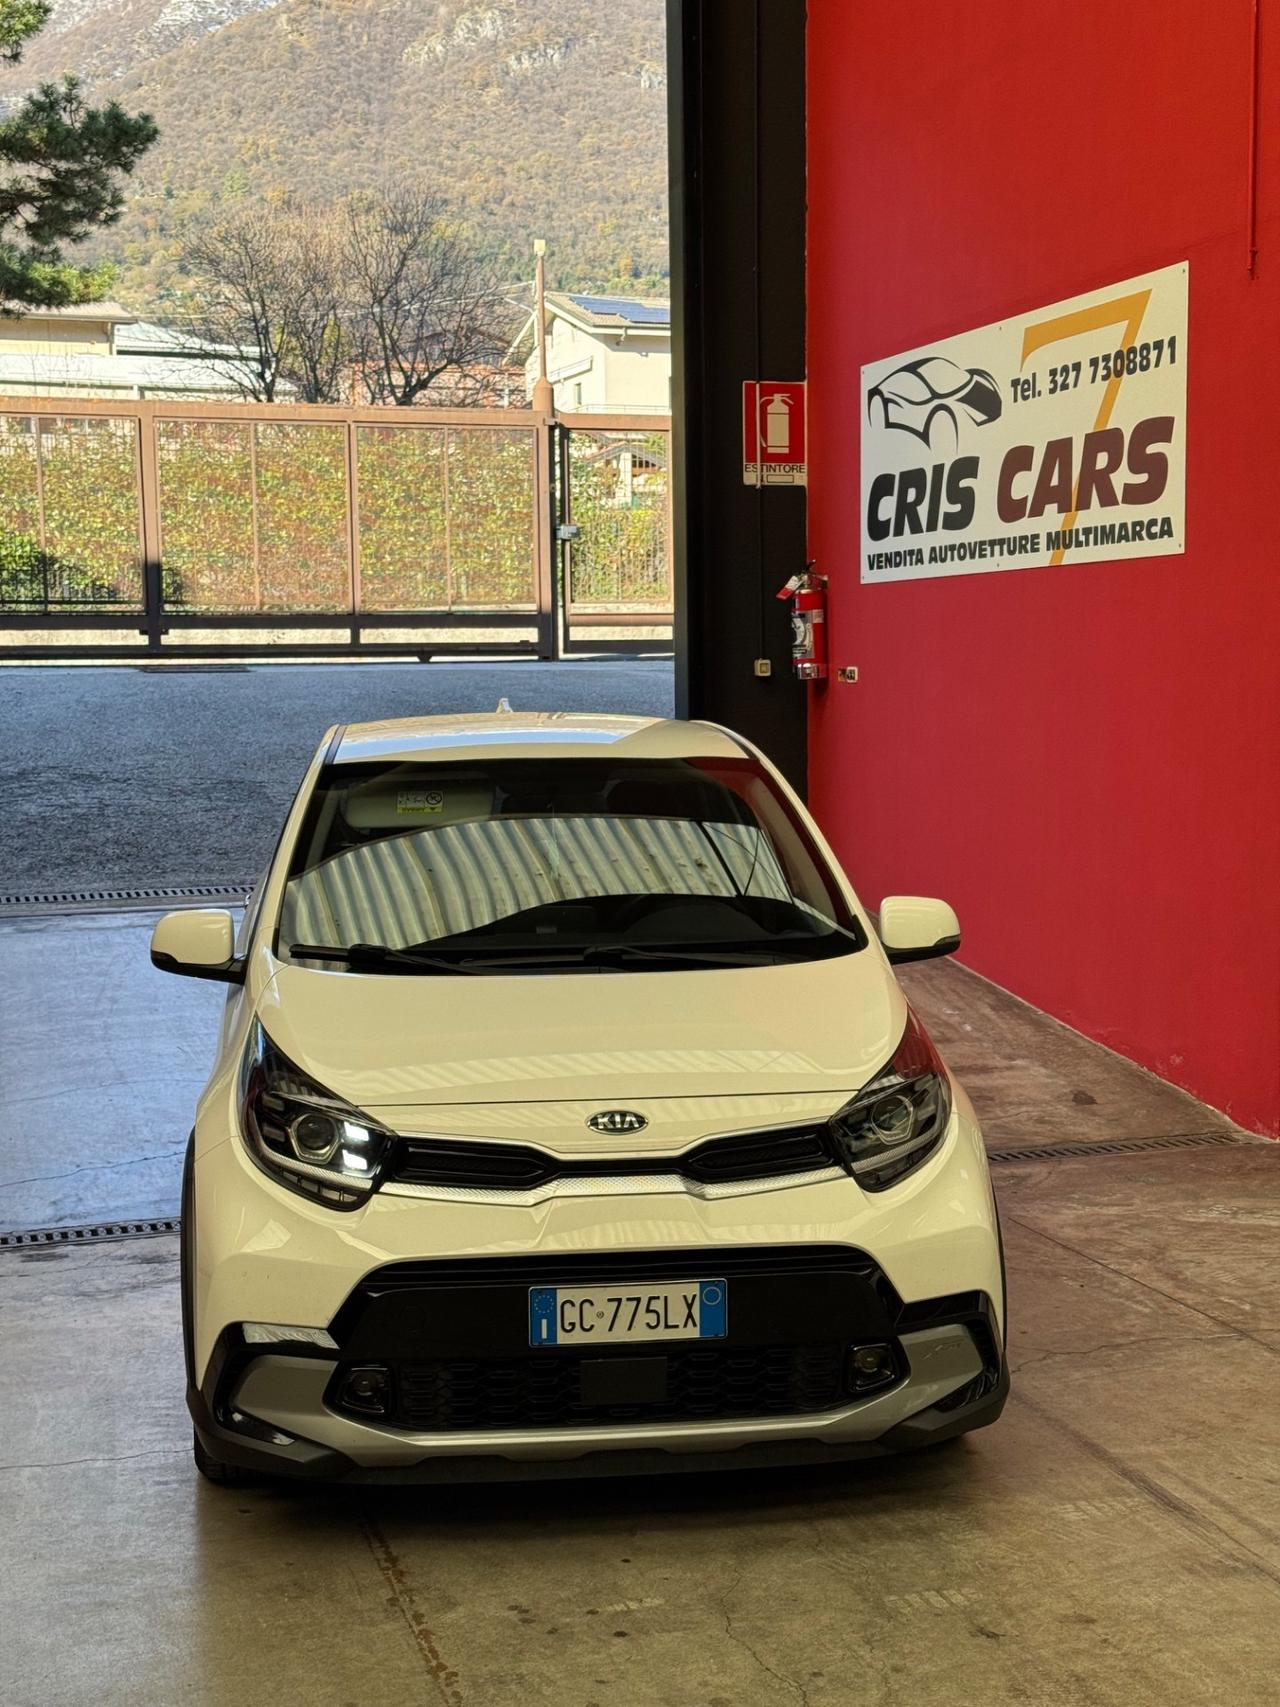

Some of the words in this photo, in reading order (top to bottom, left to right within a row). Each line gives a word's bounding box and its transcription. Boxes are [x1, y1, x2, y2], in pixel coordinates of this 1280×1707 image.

[1010, 373, 1041, 403] Tel.
[1048, 361, 1082, 395] 327
[1089, 335, 1177, 385] 7308871
[745, 464, 806, 473] ESTINTORE
[867, 455, 980, 542] CRIS
[996, 416, 1175, 523] CARS
[867, 550, 924, 571] VENDITA
[928, 533, 1040, 563] AUTOVETTURE
[1046, 516, 1174, 551] MULTIMARCA
[597, 1113, 640, 1129] KIA
